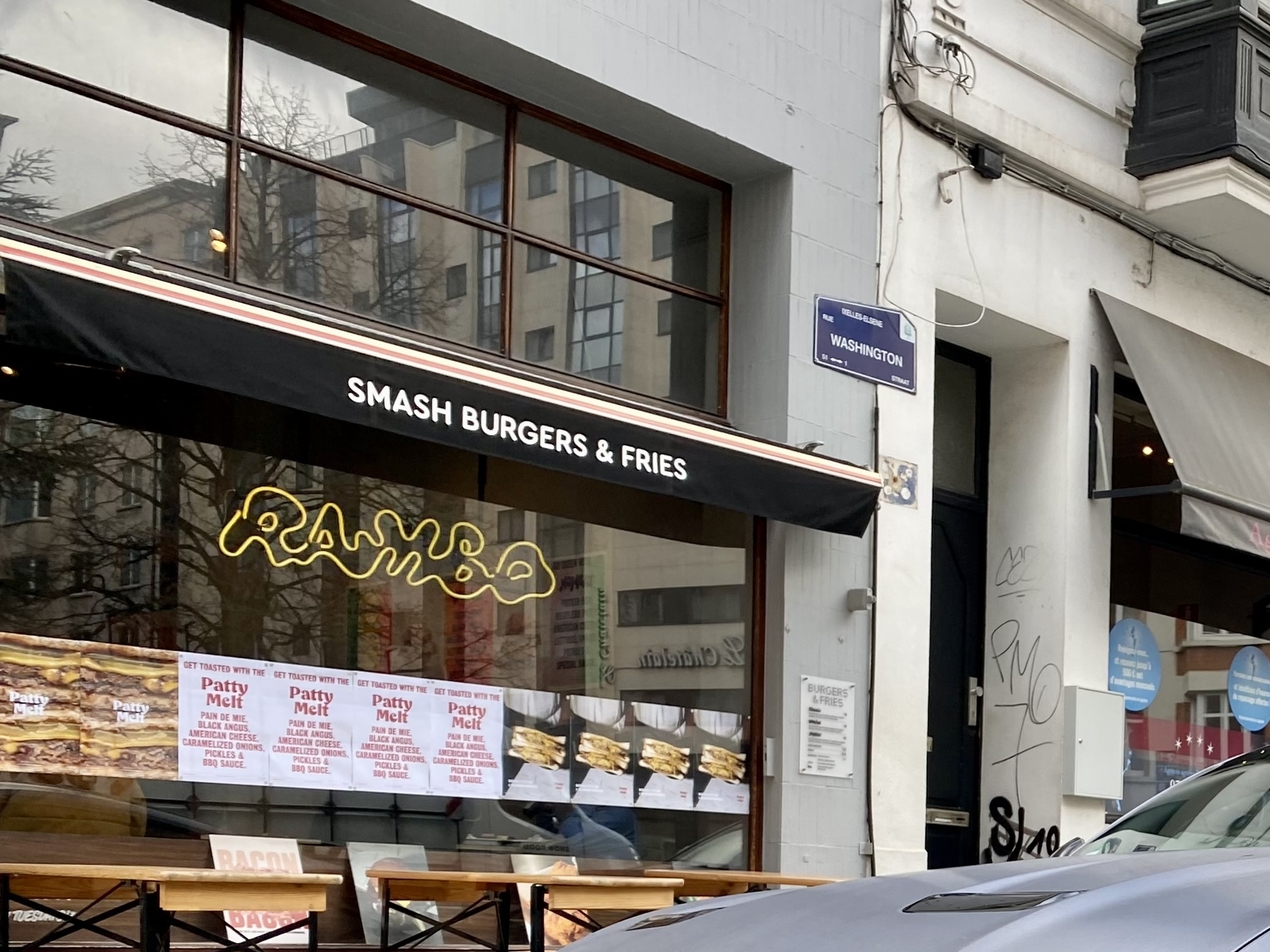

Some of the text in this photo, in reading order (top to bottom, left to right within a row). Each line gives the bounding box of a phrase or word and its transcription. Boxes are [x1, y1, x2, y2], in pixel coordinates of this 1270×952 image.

[822, 314, 834, 322] RUE
[842, 308, 883, 328] IXELLES-ELSENE
[830, 333, 903, 367] WASHINGTON
[891, 375, 910, 385] STRAAT
[348, 376, 688, 480] SMASH BURGERS & FRIES
[200, 663, 230, 673] TOASTED
[274, 671, 286, 679] GET
[289, 673, 317, 682] TOASTED
[201, 677, 248, 696] Patty
[371, 681, 397, 690] TOASTED
[808, 683, 848, 698] BURGERS
[290, 686, 333, 705] Patty
[448, 689, 471, 698] TOASTED
[9, 691, 49, 707] Patty
[207, 693, 243, 708] Melt
[372, 695, 412, 712] Patty
[820, 696, 844, 707] FRIES
[13, 704, 45, 717] Melt
[113, 700, 149, 714] Patty
[294, 702, 329, 716] Melt
[448, 702, 486, 719] Patty
[116, 712, 145, 724] Melt
[201, 712, 217, 720] PAIN
[376, 709, 408, 723] Melt
[198, 721, 221, 730] BLACK
[289, 720, 305, 728] PAIN
[452, 717, 481, 730] Melt
[189, 730, 226, 739] AMERICAN
[287, 729, 308, 737] BLACK
[448, 733, 461, 741] PAIN
[183, 738, 233, 749] CARAMELIZED
[278, 737, 312, 746] AMERICAN
[369, 735, 389, 743] BLACK
[361, 743, 393, 752] AMERICAN
[446, 741, 464, 749] BLACK
[205, 750, 235, 759] PICKLES
[272, 746, 319, 755] CARAMELIZED
[438, 749, 468, 758] AMERICAN
[293, 756, 320, 764] PICKLES
[356, 751, 399, 761] CARAMELIZED
[203, 759, 217, 768] BBQ
[433, 757, 473, 767] CARAMELIZED
[292, 765, 305, 773] BBQ
[451, 767, 475, 775] PICKLES
[373, 770, 386, 779] BBQ
[449, 775, 461, 783] BBQ
